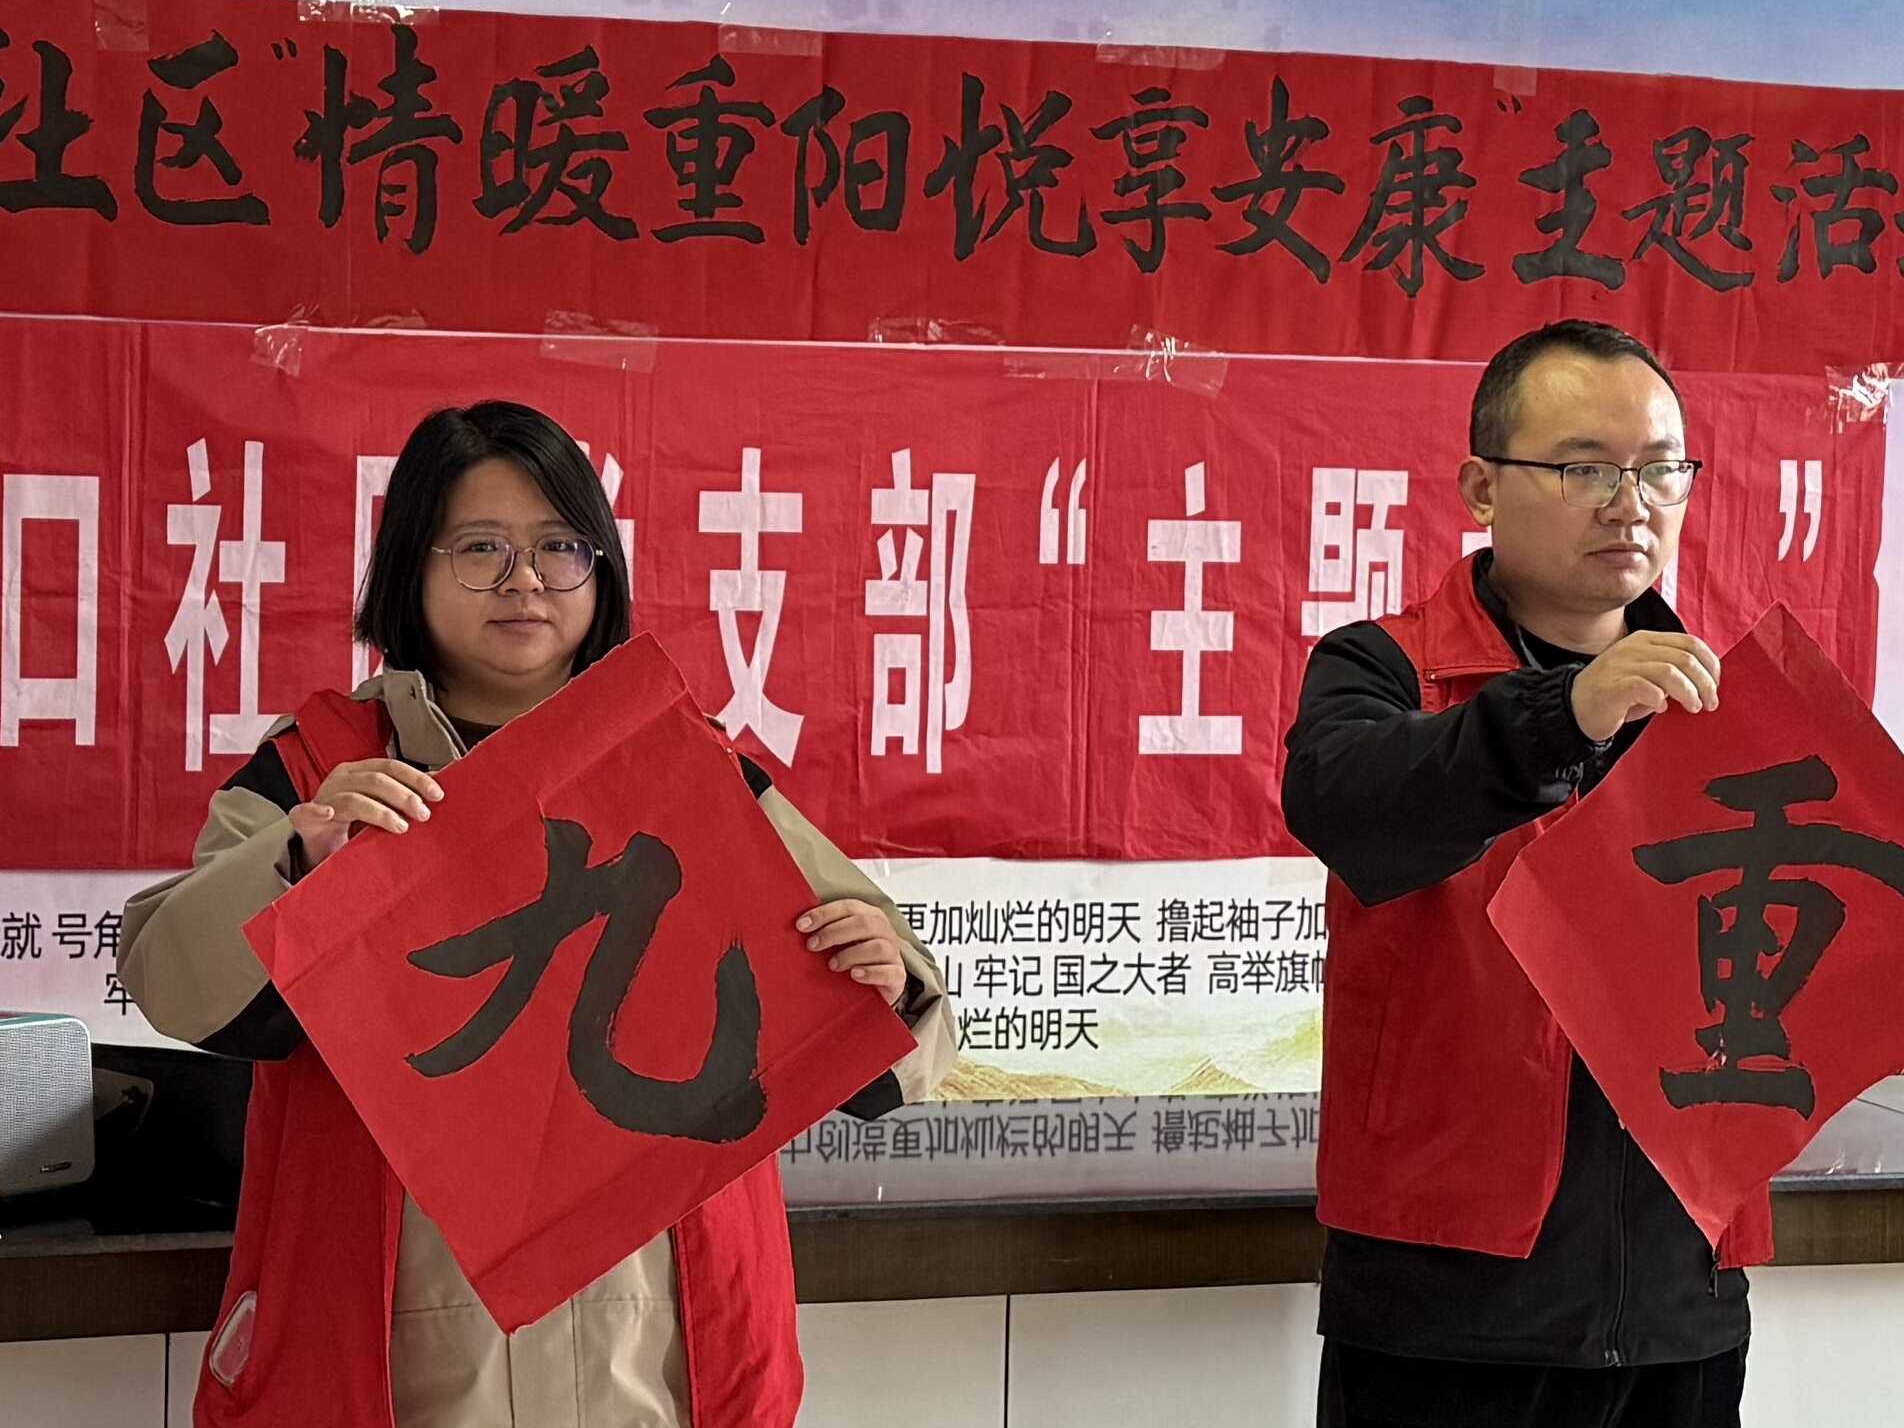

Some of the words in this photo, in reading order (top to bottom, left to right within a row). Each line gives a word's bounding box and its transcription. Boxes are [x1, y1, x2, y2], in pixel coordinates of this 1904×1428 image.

[1156, 898, 1327, 943] 撸起袖子加
[405, 815, 768, 1144] 九
[973, 955, 1043, 999] 牢记
[1053, 953, 1192, 995] 国之大者
[957, 1007, 1099, 1052] 烂的明天
